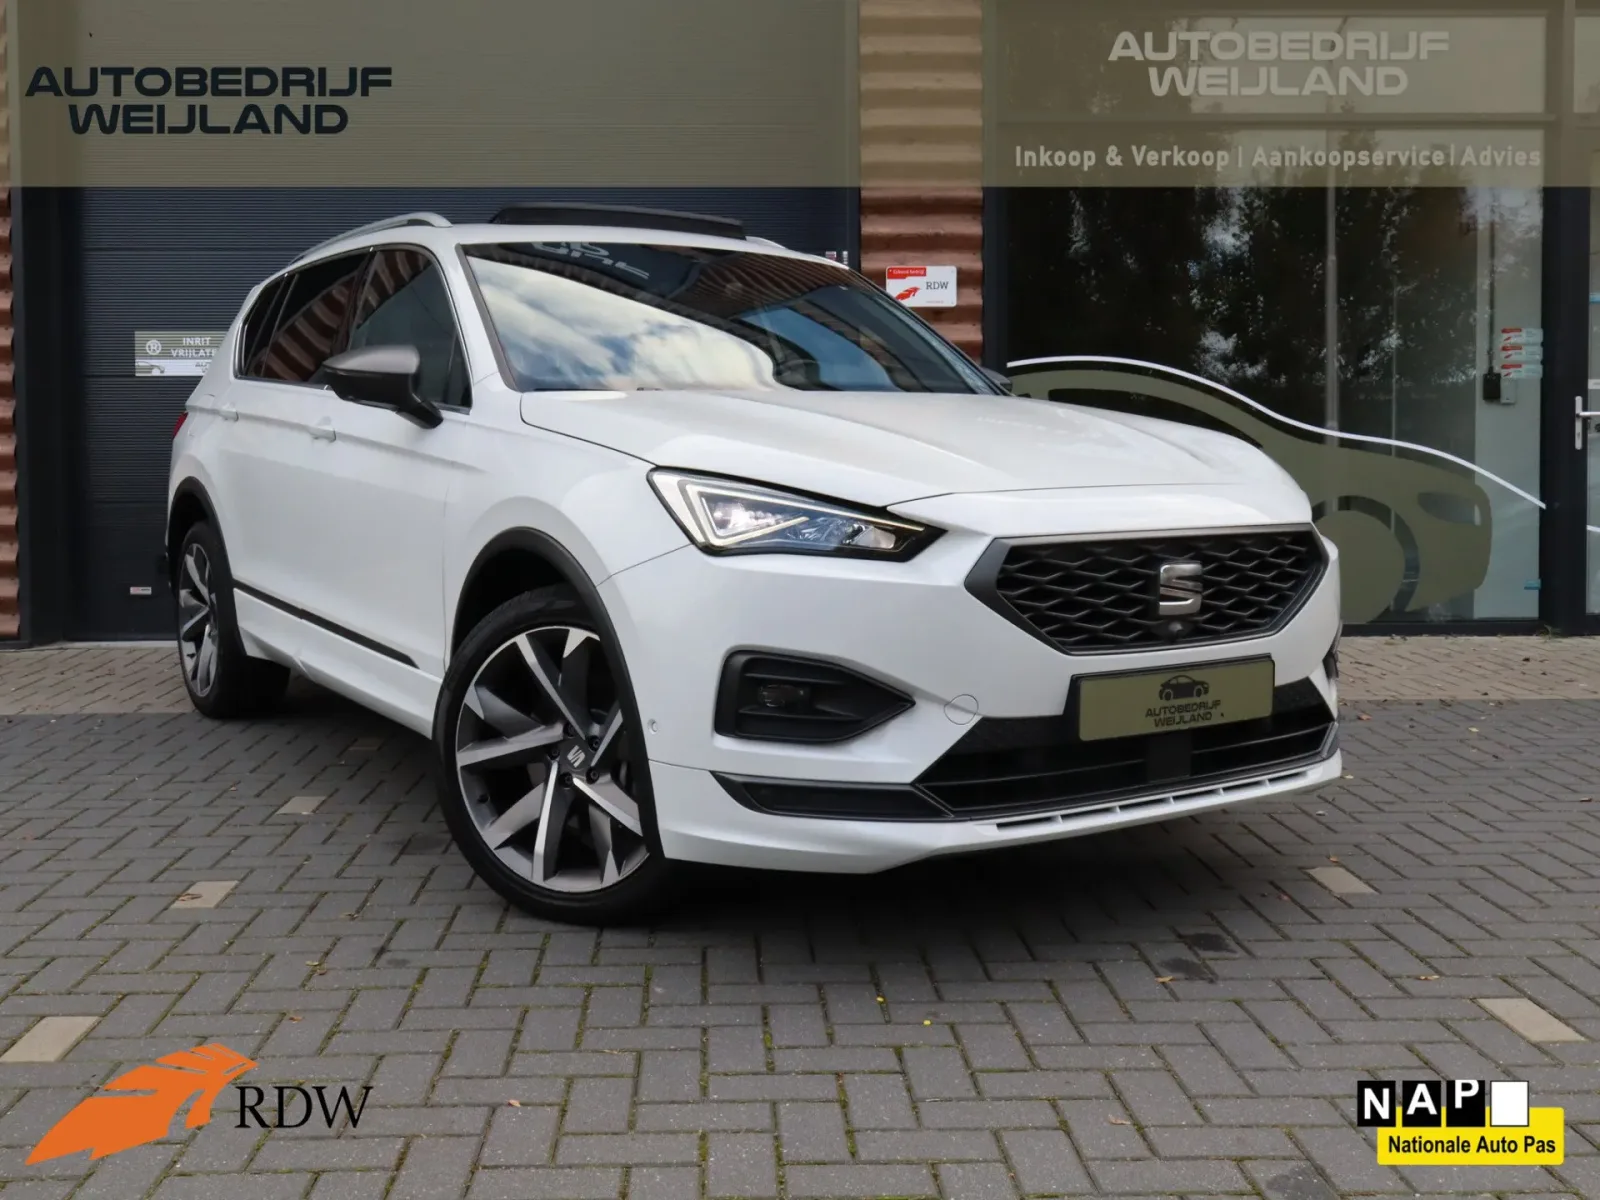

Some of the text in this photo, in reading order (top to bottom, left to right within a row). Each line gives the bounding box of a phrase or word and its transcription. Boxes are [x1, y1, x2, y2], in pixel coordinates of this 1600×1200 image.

[1107, 31, 1449, 61] AUTOBEDRIJF
[1148, 66, 1409, 97] WEIJLAND
[1015, 145, 1096, 171] Inkoop
[1105, 145, 1123, 167] &
[1131, 145, 1229, 171] Verkoop
[1252, 145, 1444, 171] Aankoopservice
[1460, 145, 1541, 167] Advies
[925, 281, 949, 290] RDW
[182, 337, 211, 346] INRIT
